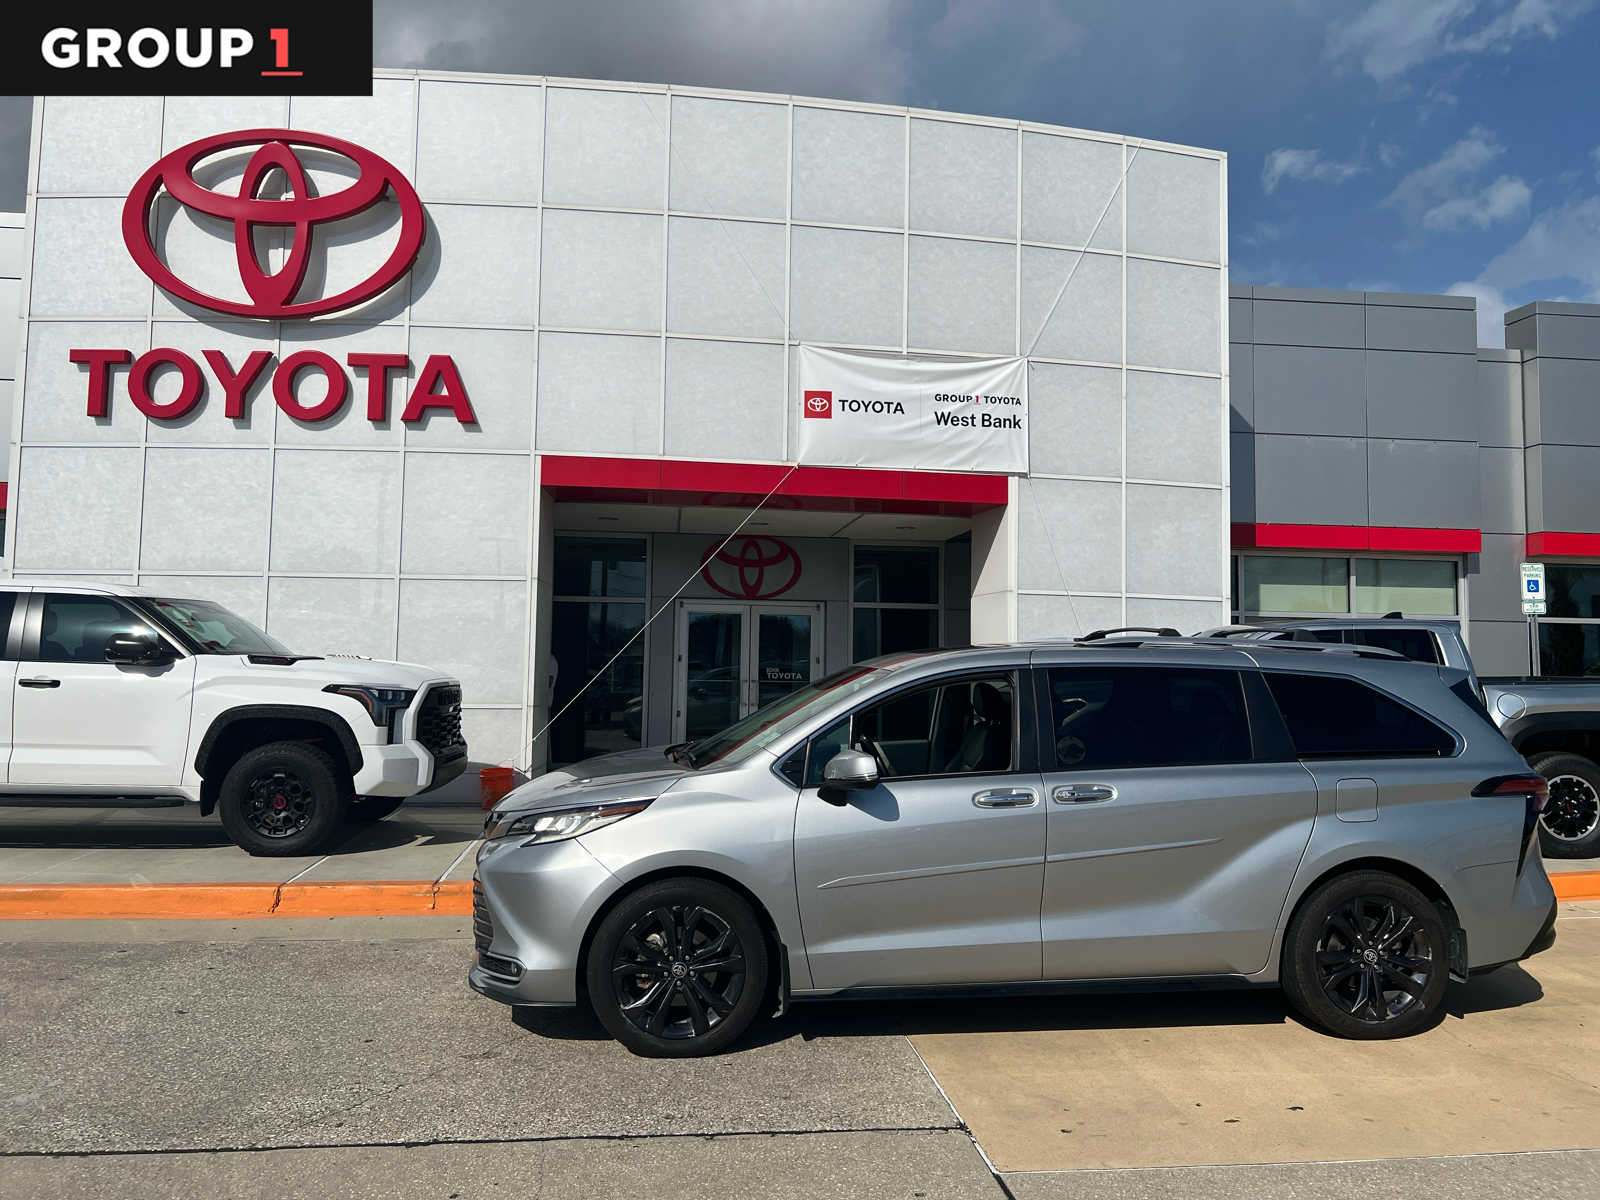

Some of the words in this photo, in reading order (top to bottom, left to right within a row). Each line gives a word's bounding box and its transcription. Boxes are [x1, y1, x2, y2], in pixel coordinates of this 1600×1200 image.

[69, 347, 477, 425] TOYOTA
[838, 399, 905, 415] TOYOTA
[934, 393, 973, 403] GROUP
[983, 395, 1022, 406] TOYOTA
[934, 411, 977, 427] West
[981, 413, 1022, 430] Bank
[767, 672, 802, 680] TOYOTA
